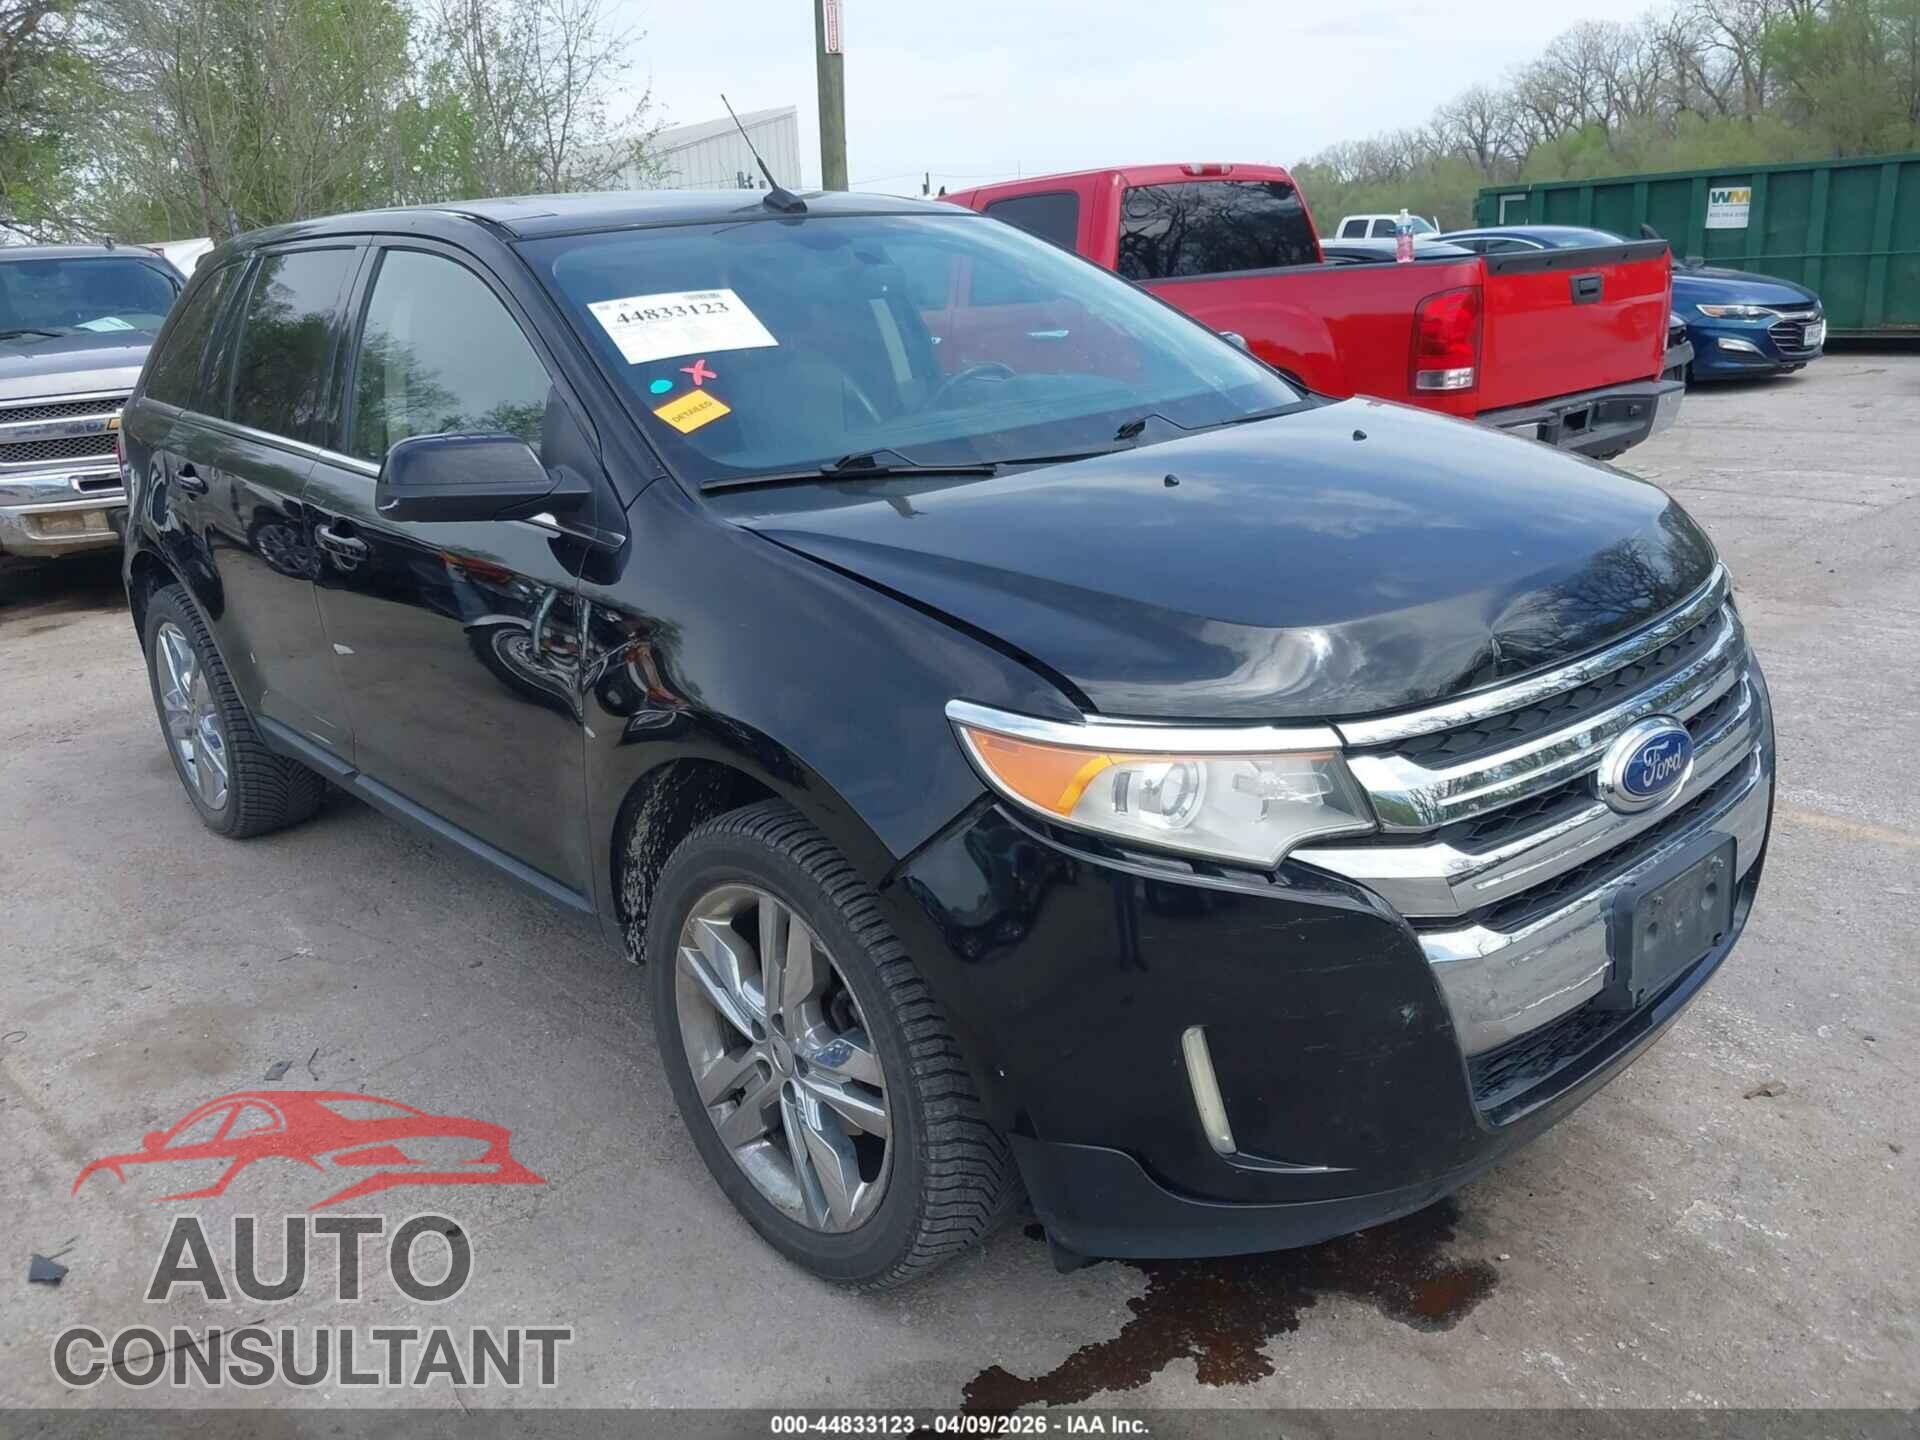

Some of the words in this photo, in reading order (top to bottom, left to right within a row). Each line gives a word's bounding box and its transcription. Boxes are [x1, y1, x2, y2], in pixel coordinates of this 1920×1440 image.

[1711, 191, 1750, 204] WM
[617, 302, 729, 323] 44833123
[1642, 740, 1681, 788] Ford
